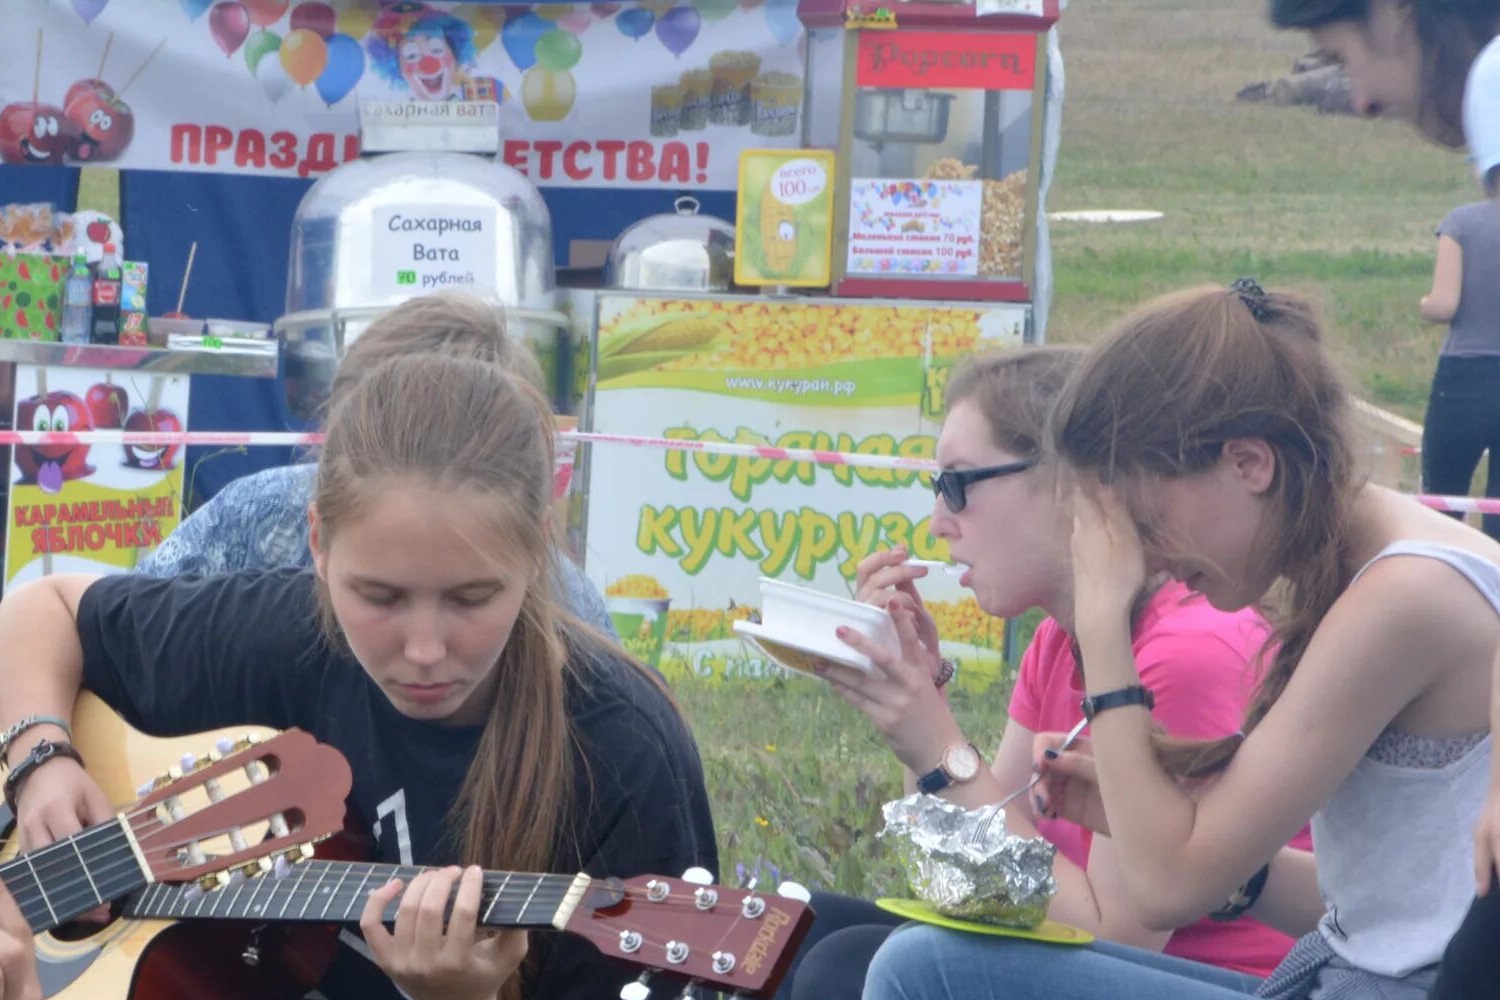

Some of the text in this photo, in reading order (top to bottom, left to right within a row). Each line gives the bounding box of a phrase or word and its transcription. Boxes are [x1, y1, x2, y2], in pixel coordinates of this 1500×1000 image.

[863, 40, 1025, 76] Popcorn
[503, 139, 710, 184] ЕТСТВА!
[779, 178, 807, 198] 100
[388, 214, 483, 236] Сахарная
[413, 243, 460, 261] Вата
[936, 246, 954, 257] 100
[397, 270, 475, 288] 70 рублей
[30, 520, 164, 555] ЯБЛОЧКИ
[740, 905, 792, 976] Rockdale
